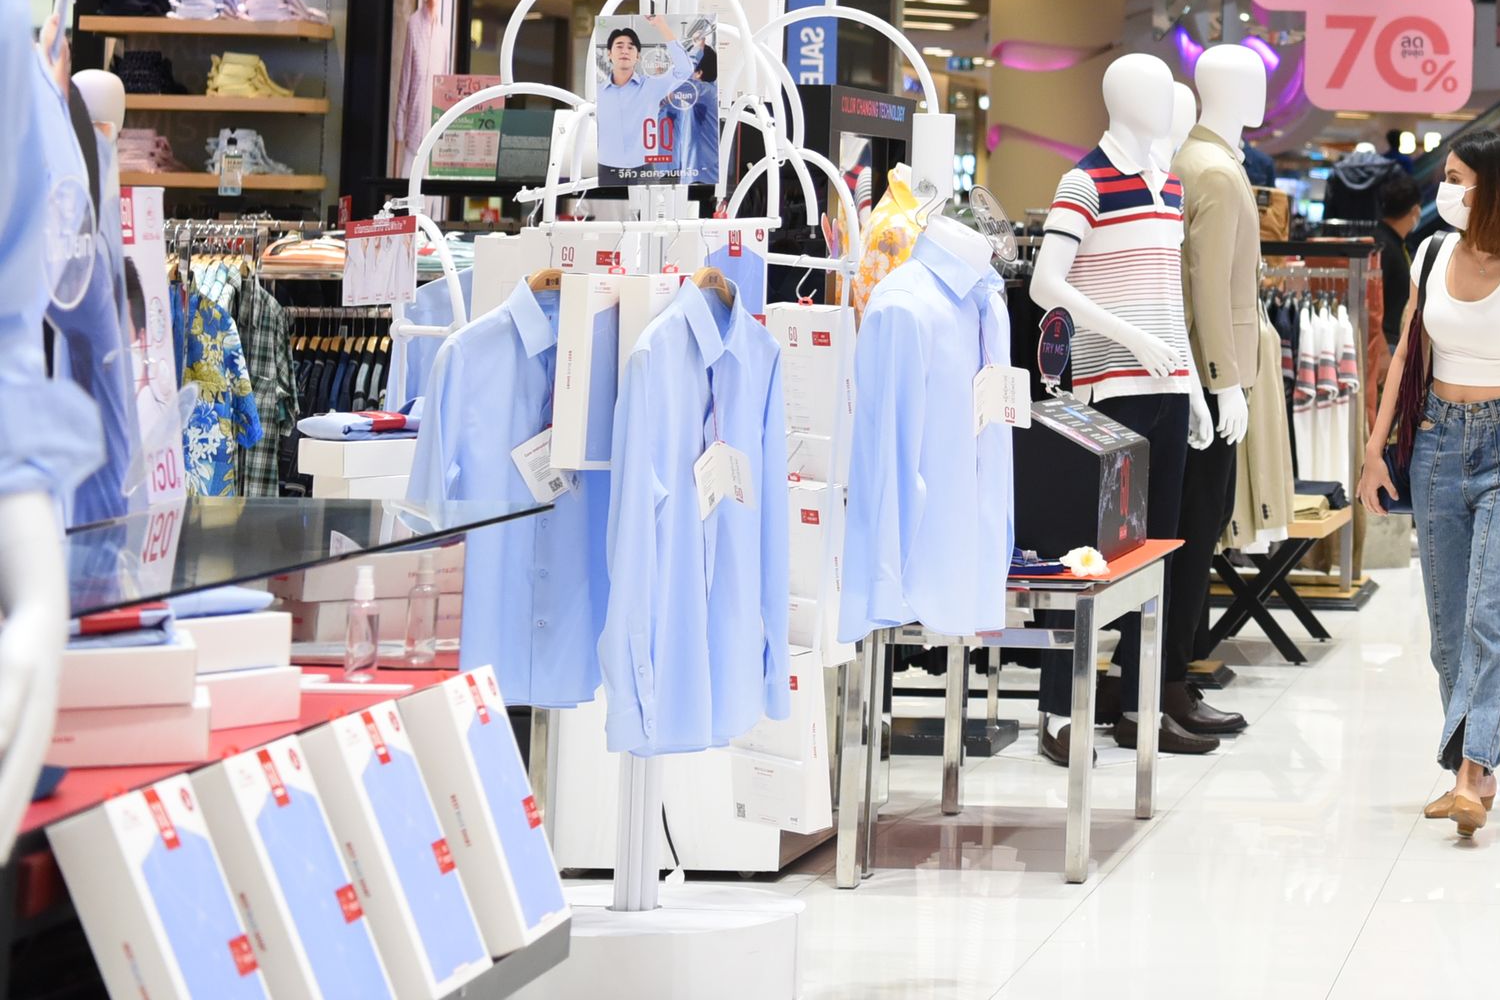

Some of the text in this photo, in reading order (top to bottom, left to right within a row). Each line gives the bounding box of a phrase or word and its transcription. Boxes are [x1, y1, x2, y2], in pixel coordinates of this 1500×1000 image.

[1401, 36, 1424, 49] ลด
[643, 117, 674, 152] GQ
[561, 246, 575, 262] GQ
[788, 326, 798, 342] GQ
[1042, 342, 1054, 354] TRY
[1004, 406, 1016, 420] GQ
